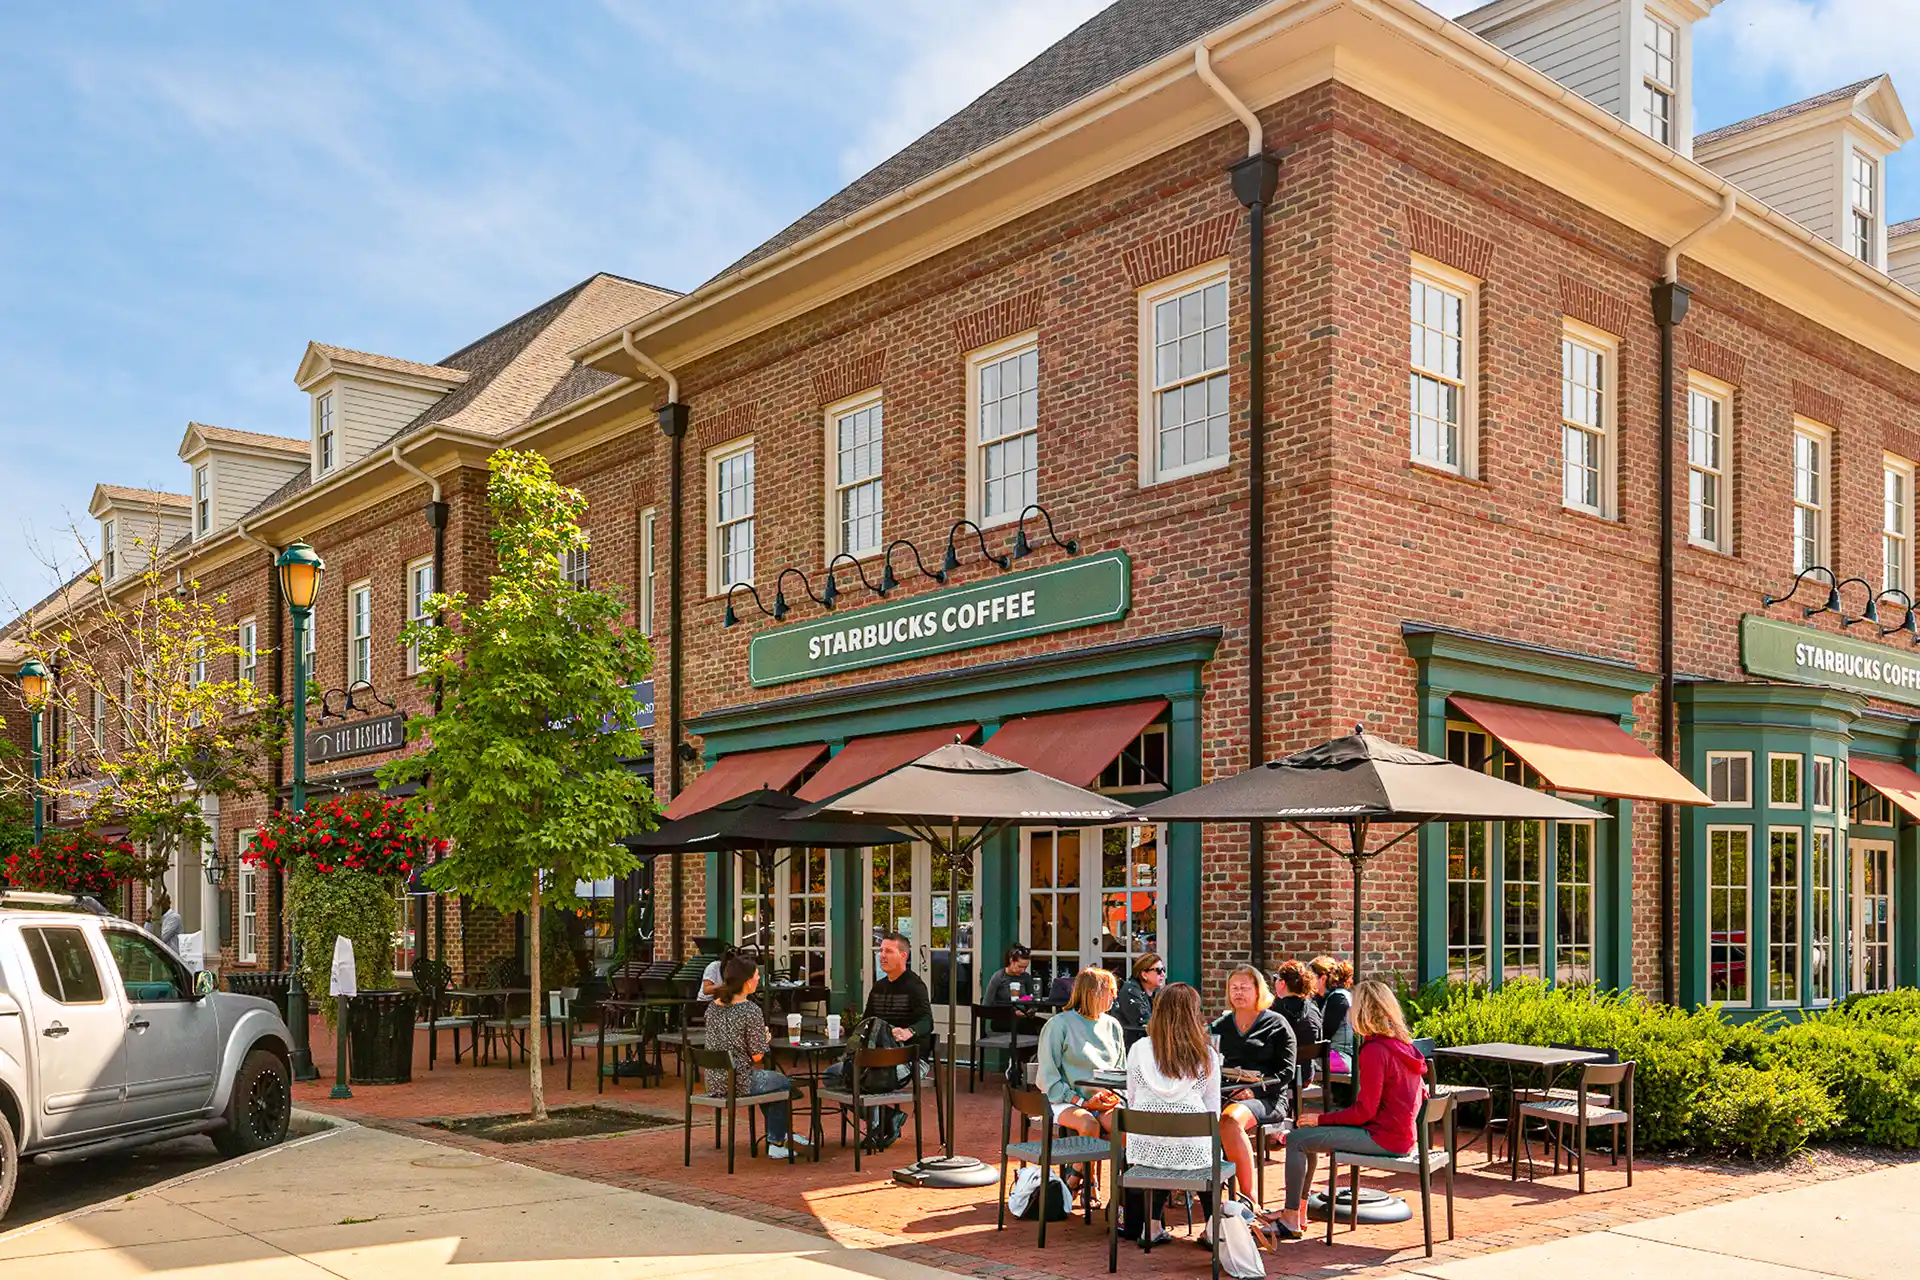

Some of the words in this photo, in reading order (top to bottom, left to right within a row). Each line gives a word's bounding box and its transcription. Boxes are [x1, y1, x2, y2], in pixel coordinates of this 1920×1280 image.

[809, 611, 938, 660] STARBUCKS
[942, 590, 1036, 633] COFFEE
[1795, 643, 1881, 681] STARBUCKS
[336, 730, 351, 753] EYE
[355, 721, 392, 749] DESIGNS
[1277, 804, 1365, 815] STARBUCKS
